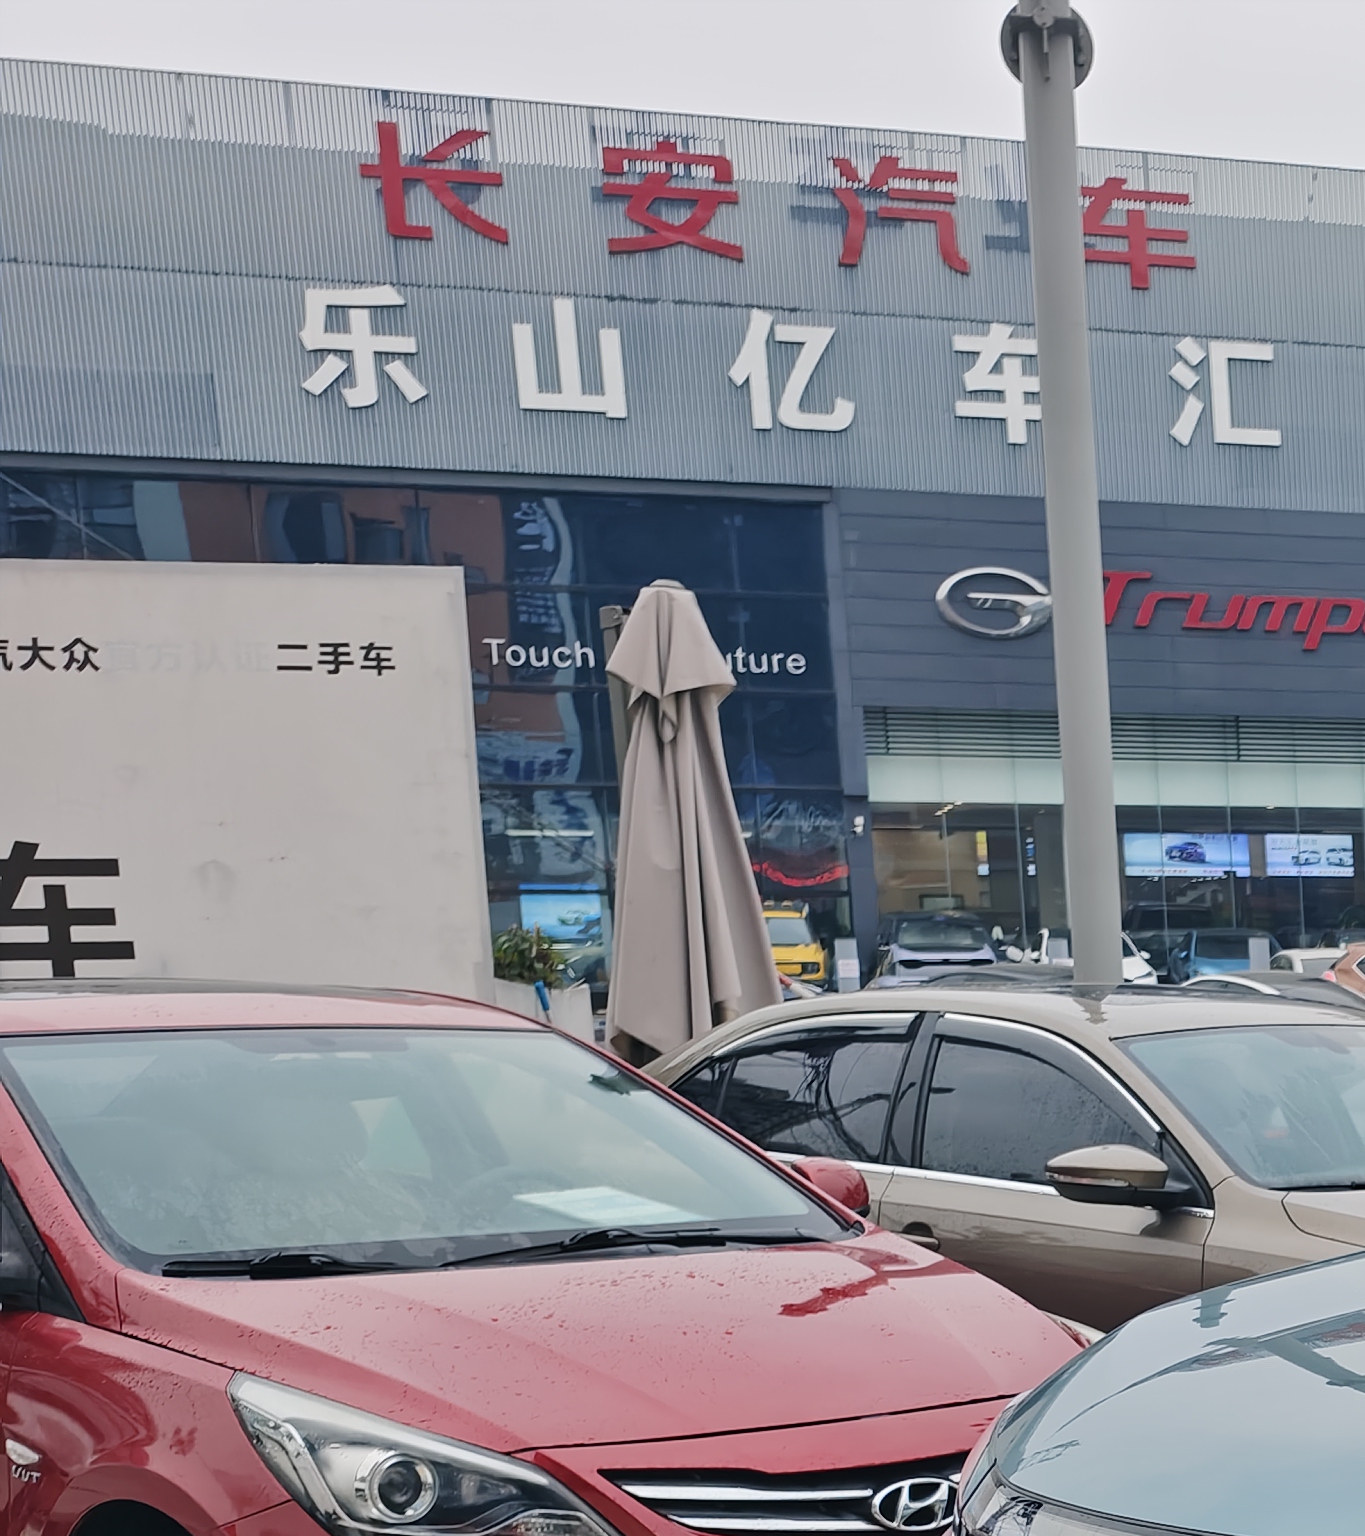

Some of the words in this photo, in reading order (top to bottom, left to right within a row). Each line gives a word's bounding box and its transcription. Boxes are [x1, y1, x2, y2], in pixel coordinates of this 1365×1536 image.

[360, 120, 1197, 290] 长安汽车
[298, 284, 1282, 447] 乐山亿车汇
[277, 642, 396, 676] 二手车
[482, 638, 596, 669] Touch
[725, 646, 807, 675] ture
